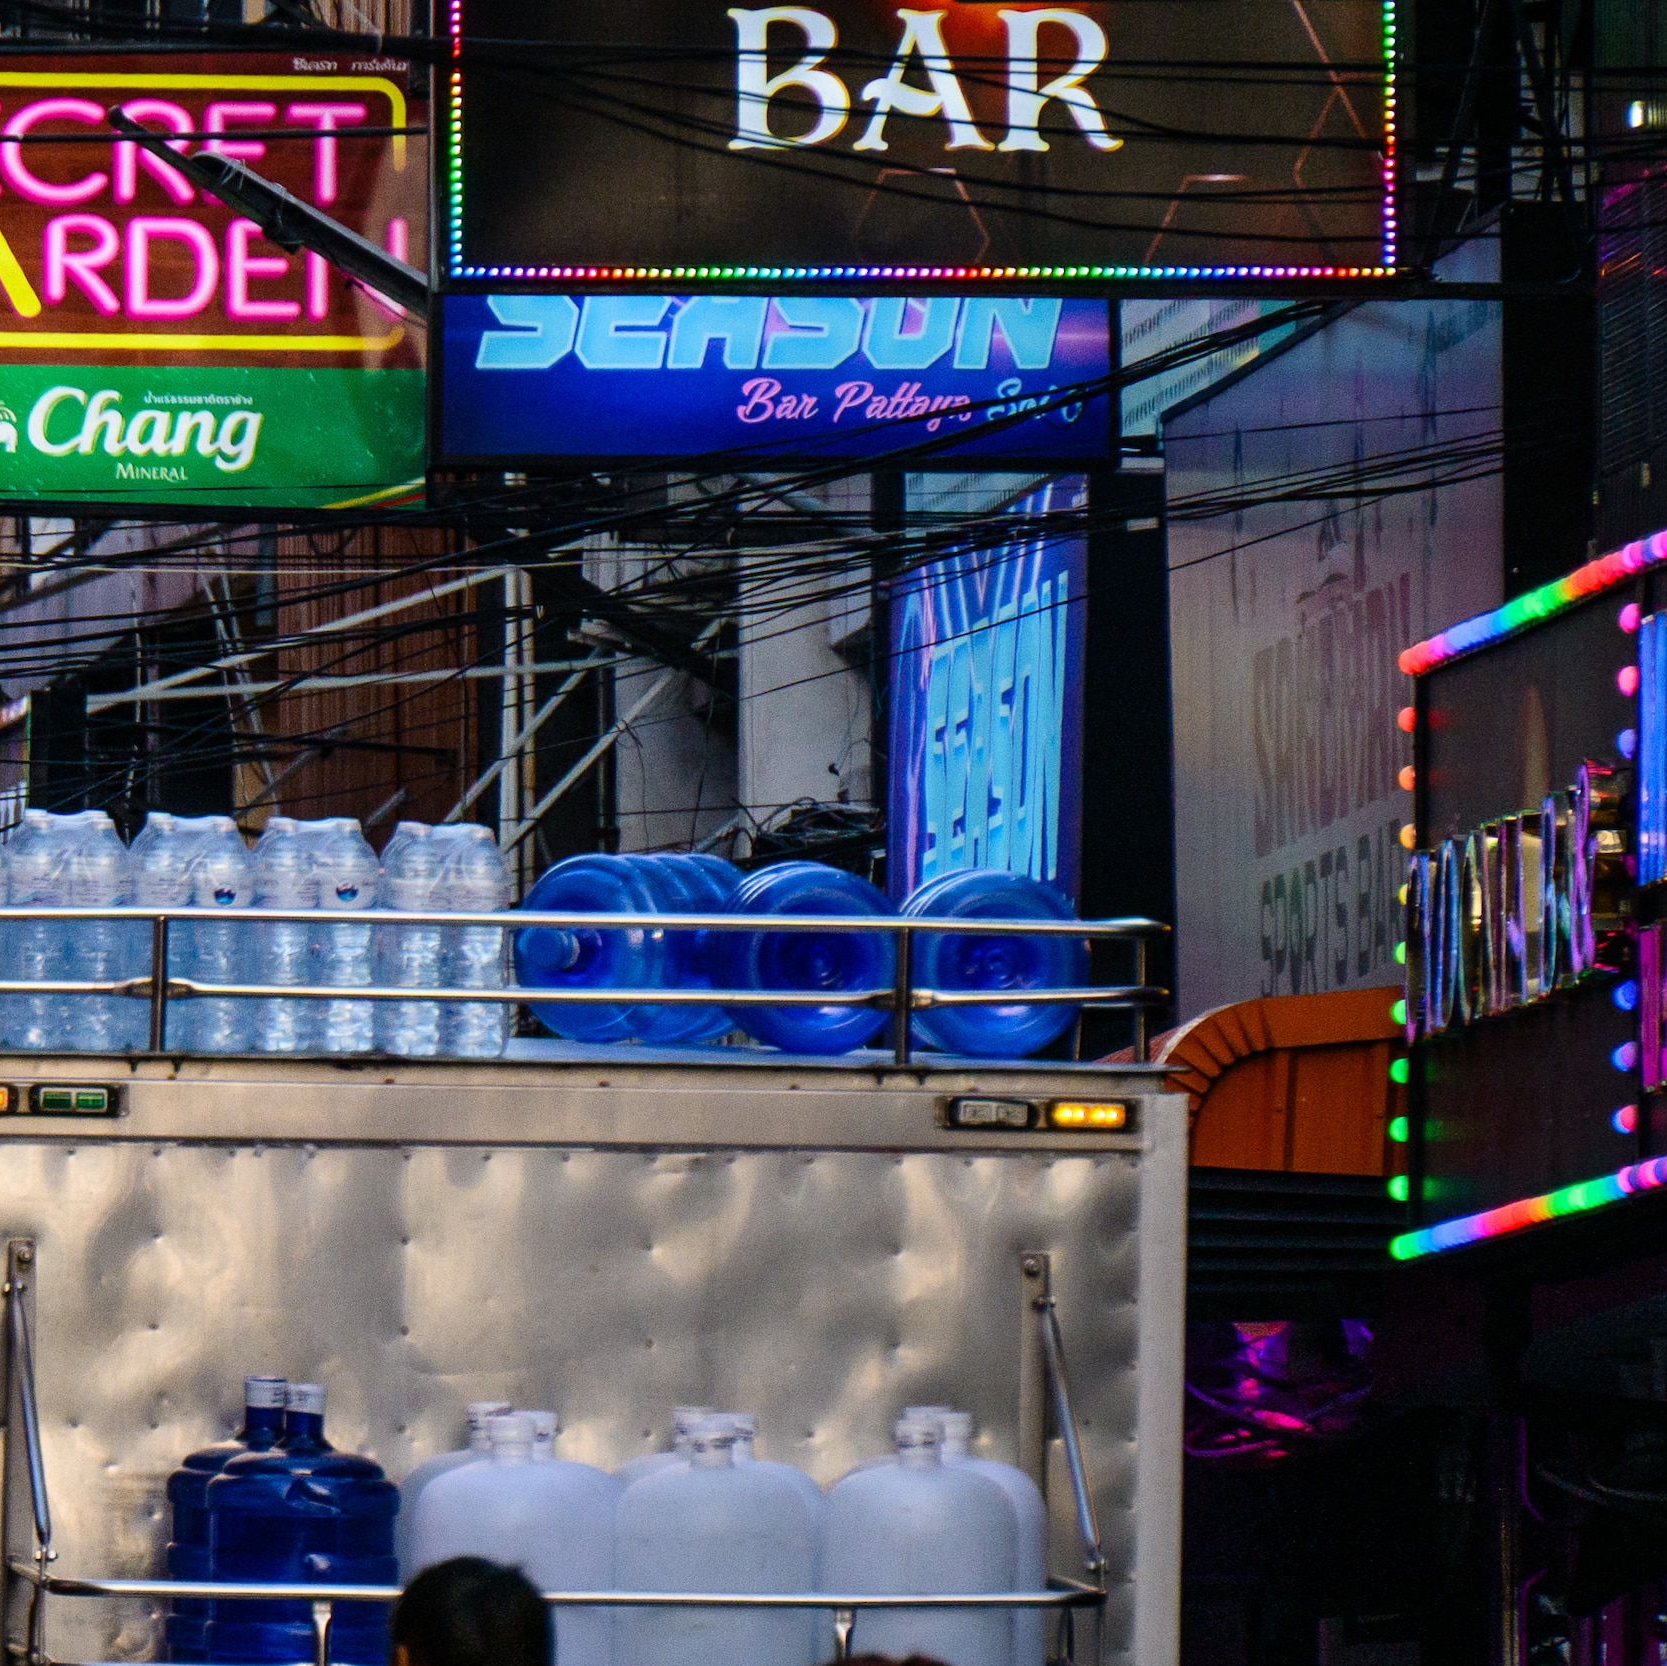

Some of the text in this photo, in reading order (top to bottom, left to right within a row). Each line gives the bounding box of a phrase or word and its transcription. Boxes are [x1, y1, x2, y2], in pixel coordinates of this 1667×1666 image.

[727, 4, 1125, 153] BAR
[27, 385, 265, 474] Chang
[737, 377, 819, 424] Bar
[116, 462, 189, 483] MINERAL
